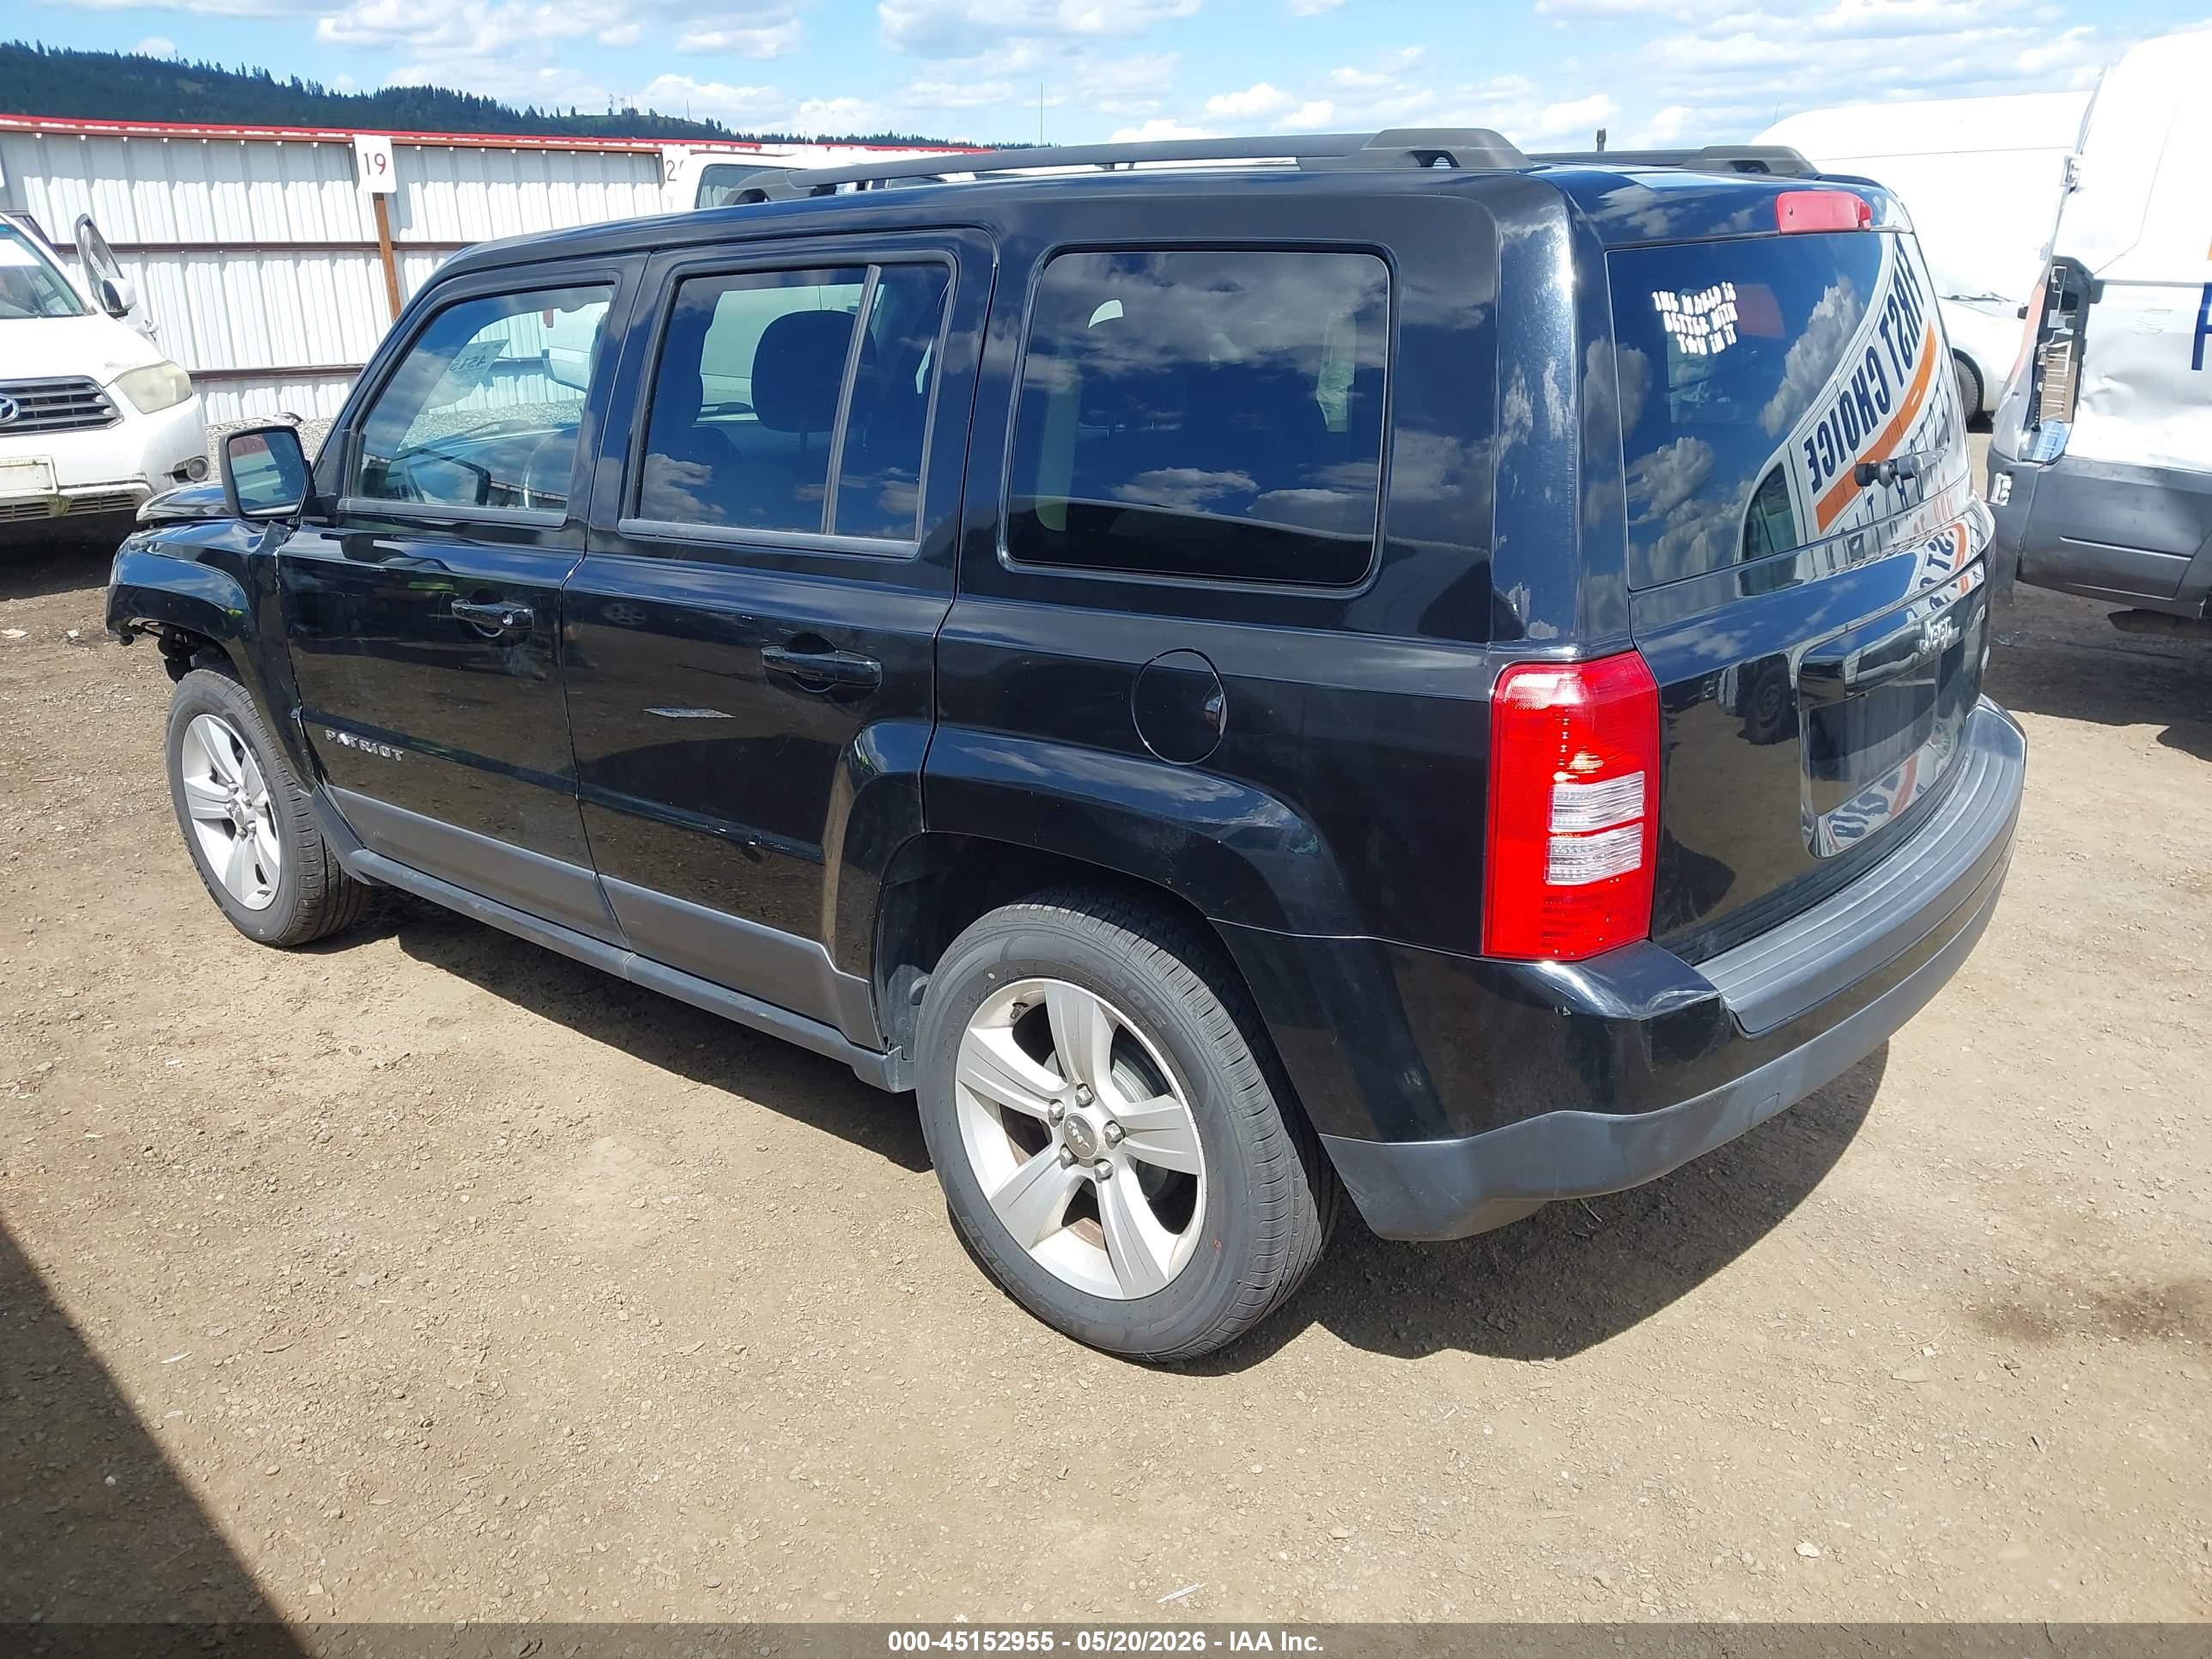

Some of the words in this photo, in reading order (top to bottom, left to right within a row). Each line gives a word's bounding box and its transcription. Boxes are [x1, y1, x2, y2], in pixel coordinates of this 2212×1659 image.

[364, 153, 386, 176] 19
[666, 160, 684, 181] 2
[1917, 616, 1952, 654] Jeep
[325, 729, 404, 762] PATRIOT
